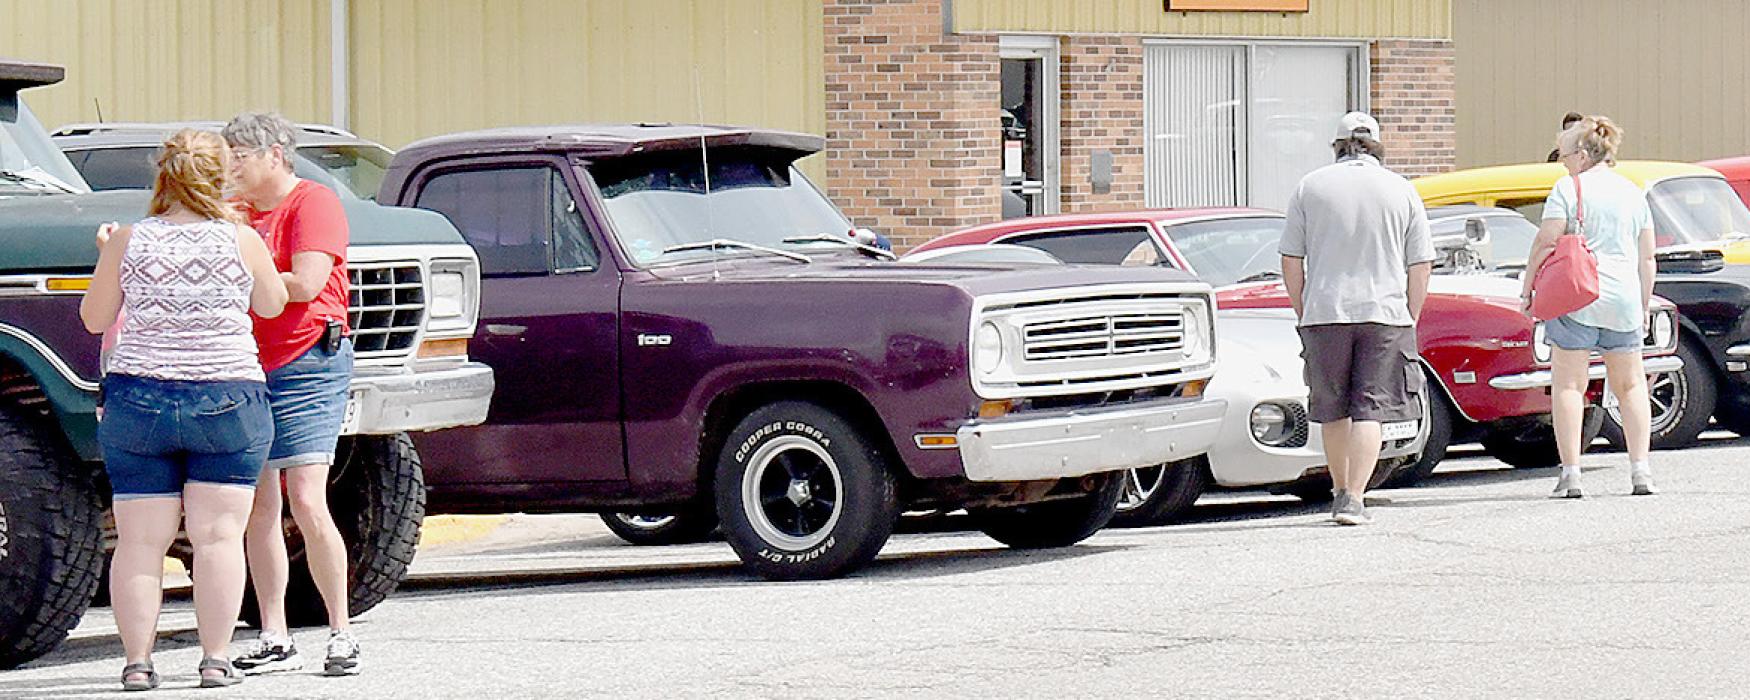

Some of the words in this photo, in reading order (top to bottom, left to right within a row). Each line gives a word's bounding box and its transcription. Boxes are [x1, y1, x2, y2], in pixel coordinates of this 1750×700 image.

[637, 334, 672, 346] 100
[736, 421, 782, 463] COOPER
[786, 421, 830, 447] COBRA
[787, 536, 836, 563] RADIAL
